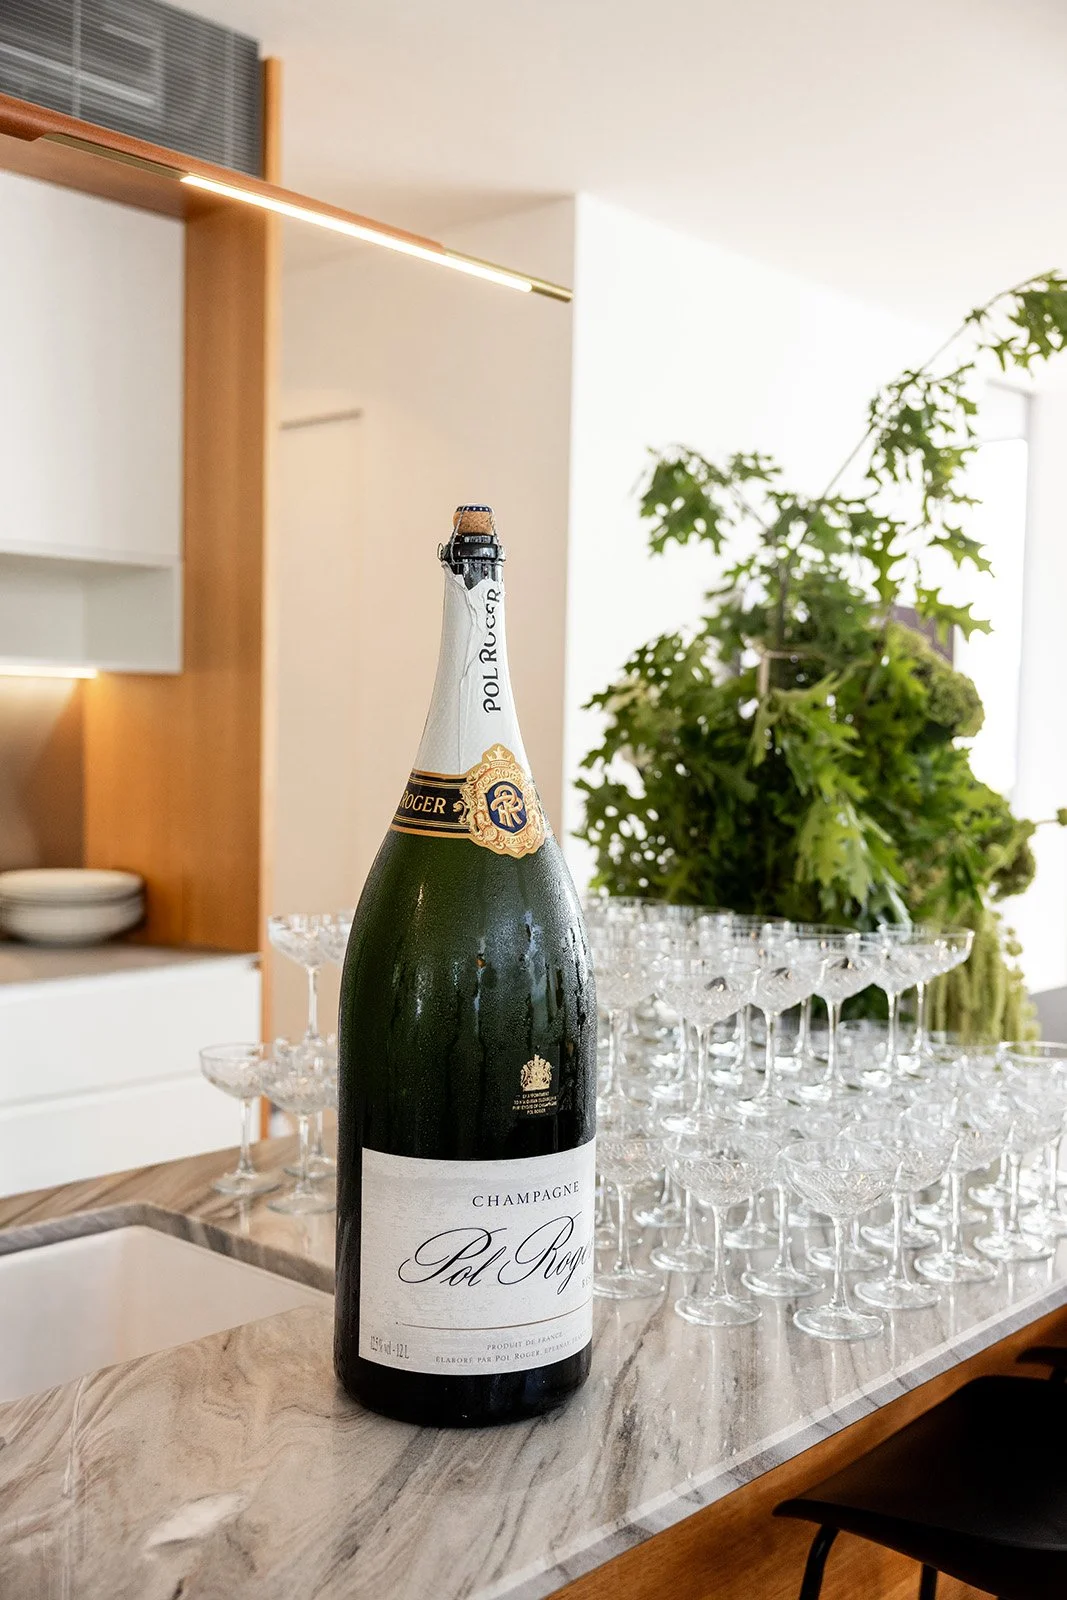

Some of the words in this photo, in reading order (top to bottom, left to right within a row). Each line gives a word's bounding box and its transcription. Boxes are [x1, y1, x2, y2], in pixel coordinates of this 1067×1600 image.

[483, 667, 501, 714] POL
[399, 790, 447, 815] ROGER
[472, 1180, 580, 1208] CHAMPAGNE
[397, 1227, 508, 1287] Pol
[486, 1341, 522, 1351] PRODUIT
[525, 1339, 535, 1347] DE
[538, 1332, 563, 1344] FRANCE
[477, 1356, 492, 1364] PAR
[495, 1354, 512, 1362] POL
